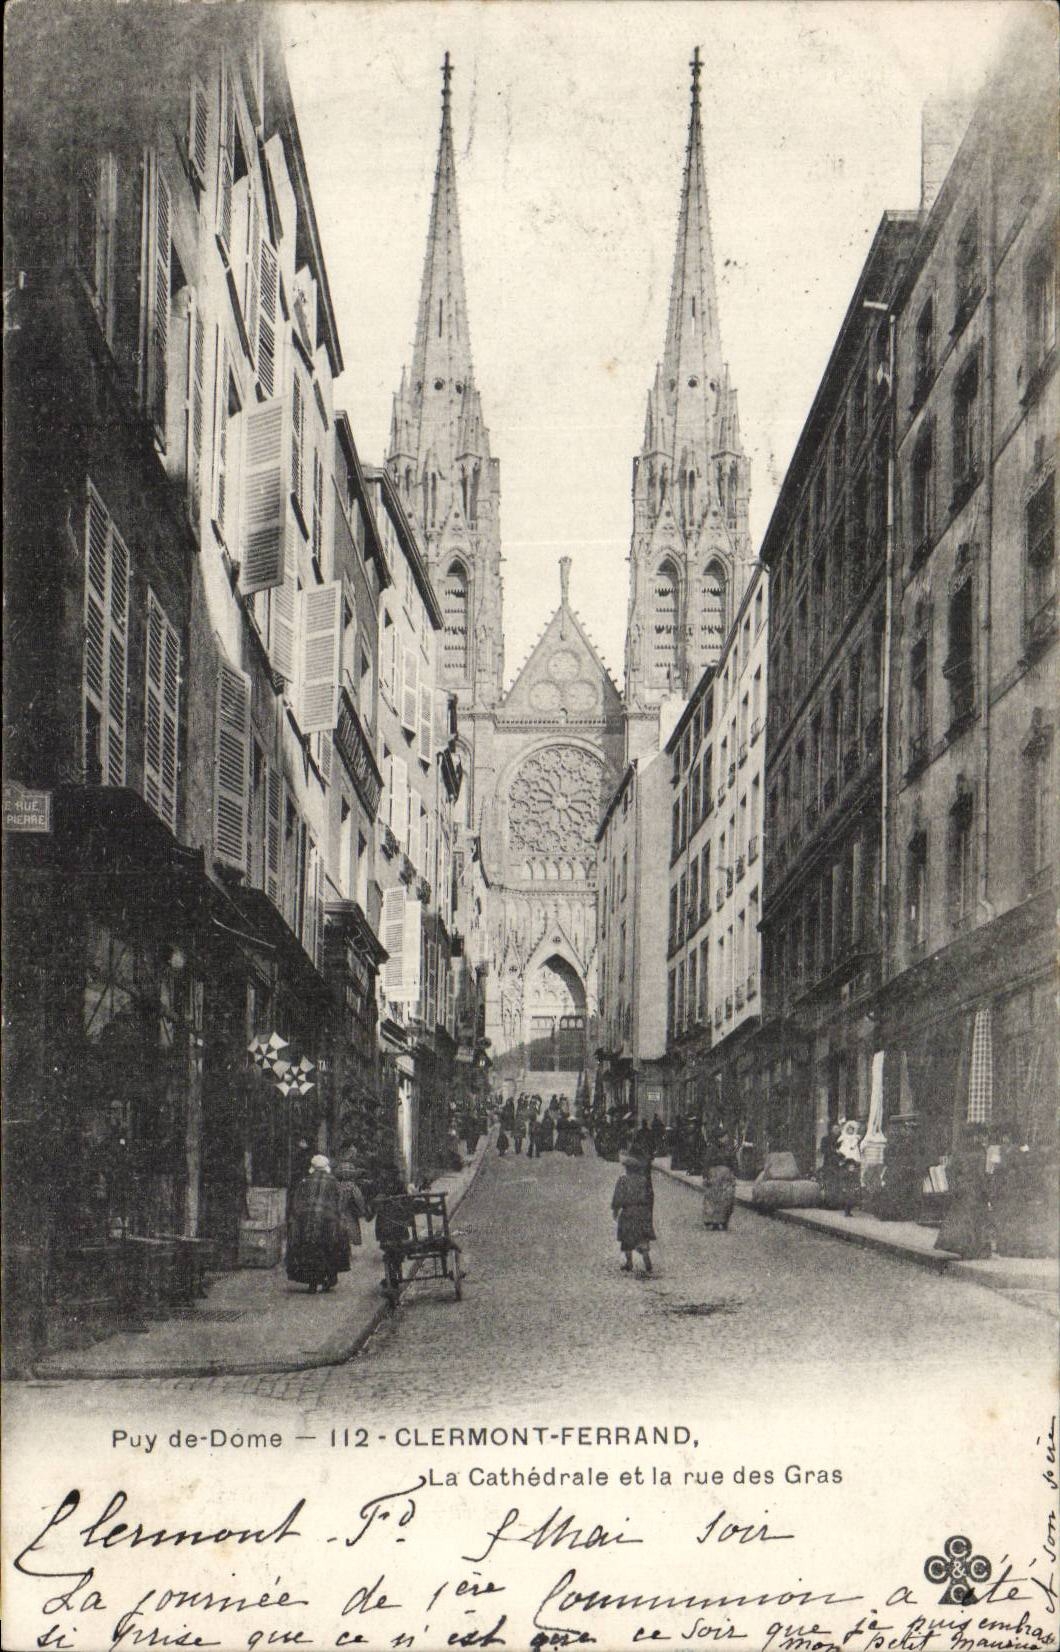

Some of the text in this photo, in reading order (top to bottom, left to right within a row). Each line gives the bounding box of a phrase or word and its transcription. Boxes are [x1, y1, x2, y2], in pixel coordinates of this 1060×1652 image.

[7, 815, 45, 825] PIERRE
[15, 800, 38, 811] RUE
[13, 1488, 306, 1577] Clermont
[113, 1575, 309, 1634] journée
[341, 1574, 402, 1616] de
[335, 1631, 369, 1647] ce
[632, 1627, 671, 1642] ce
[763, 1622, 832, 1652] que
